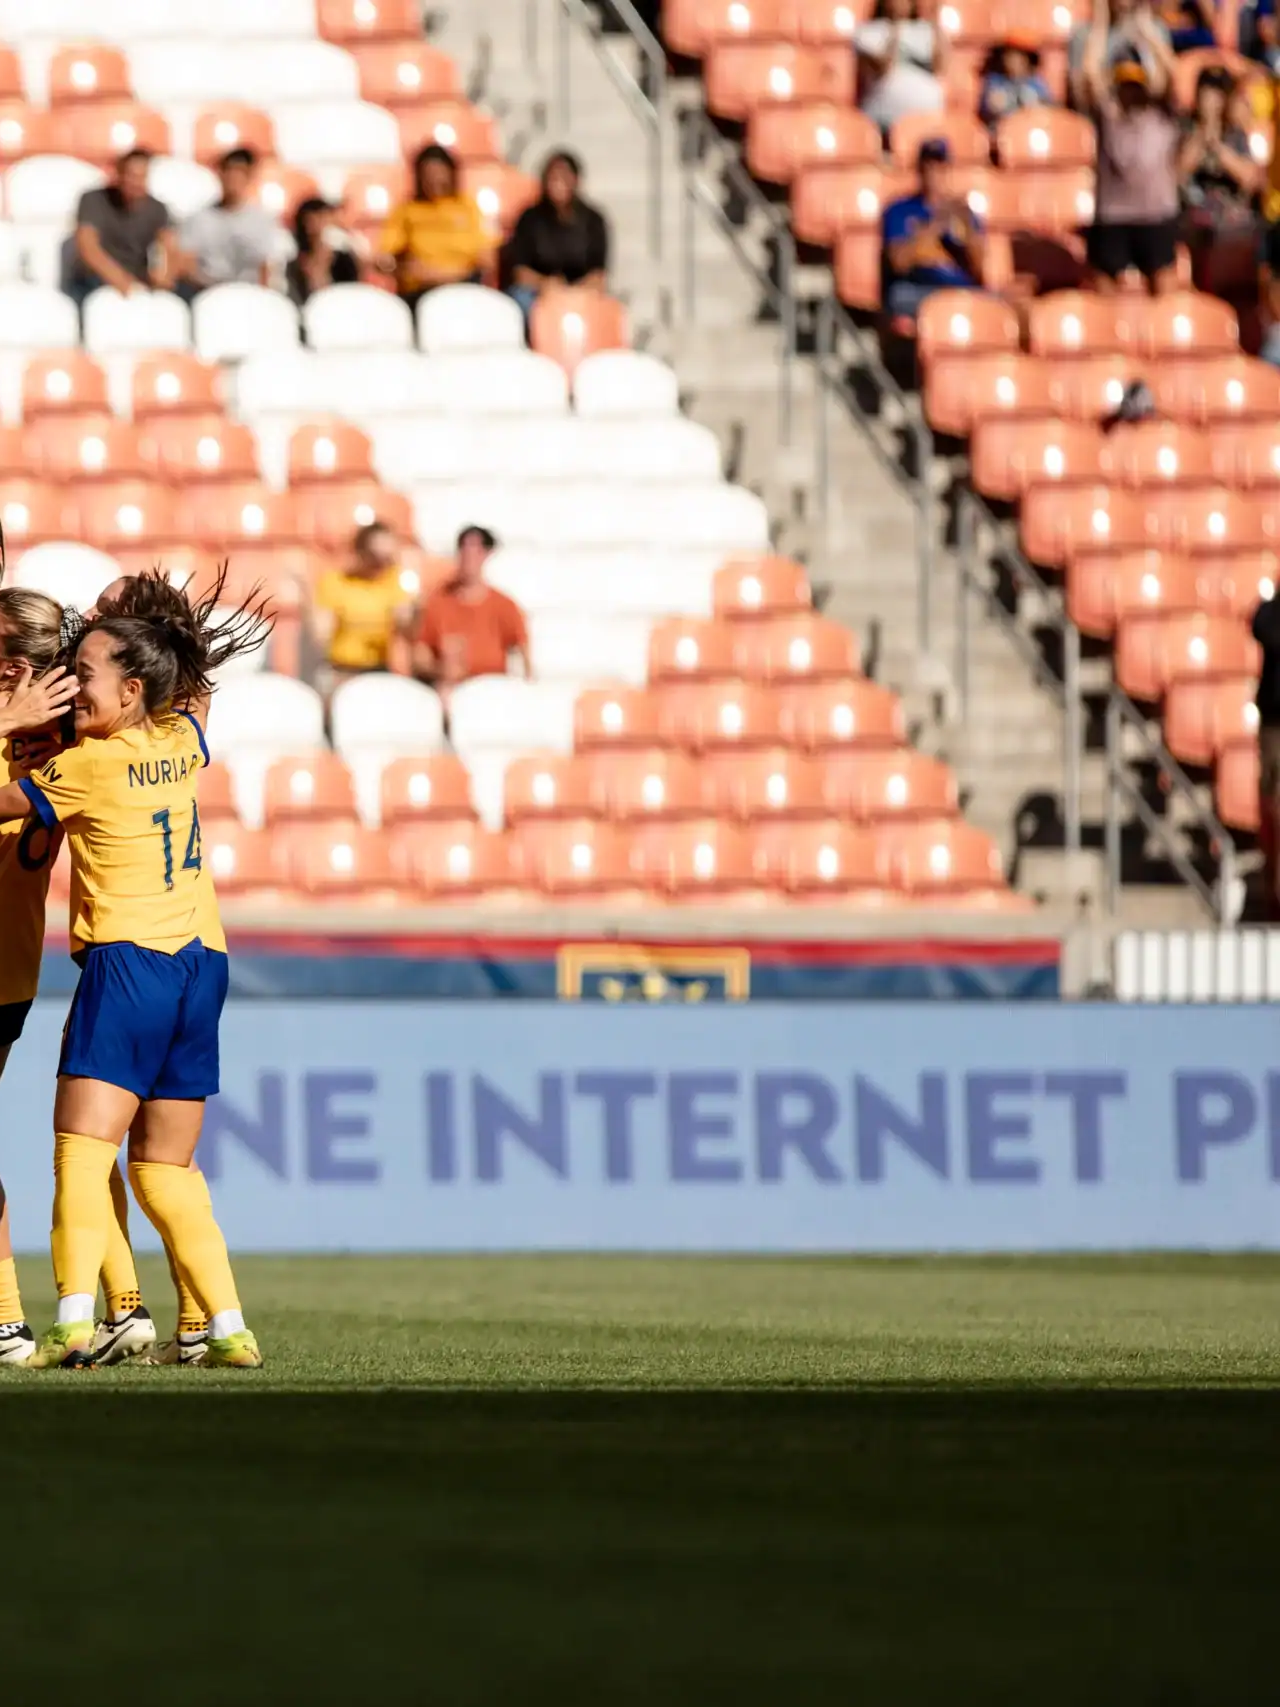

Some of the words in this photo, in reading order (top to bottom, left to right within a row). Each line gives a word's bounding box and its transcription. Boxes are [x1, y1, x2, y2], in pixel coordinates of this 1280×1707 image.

[128, 757, 188, 788] NURIA
[151, 797, 202, 892] 14
[197, 1067, 380, 1186] NE
[425, 1068, 1127, 1187] INTERNET
[1173, 1069, 1280, 1186] P
